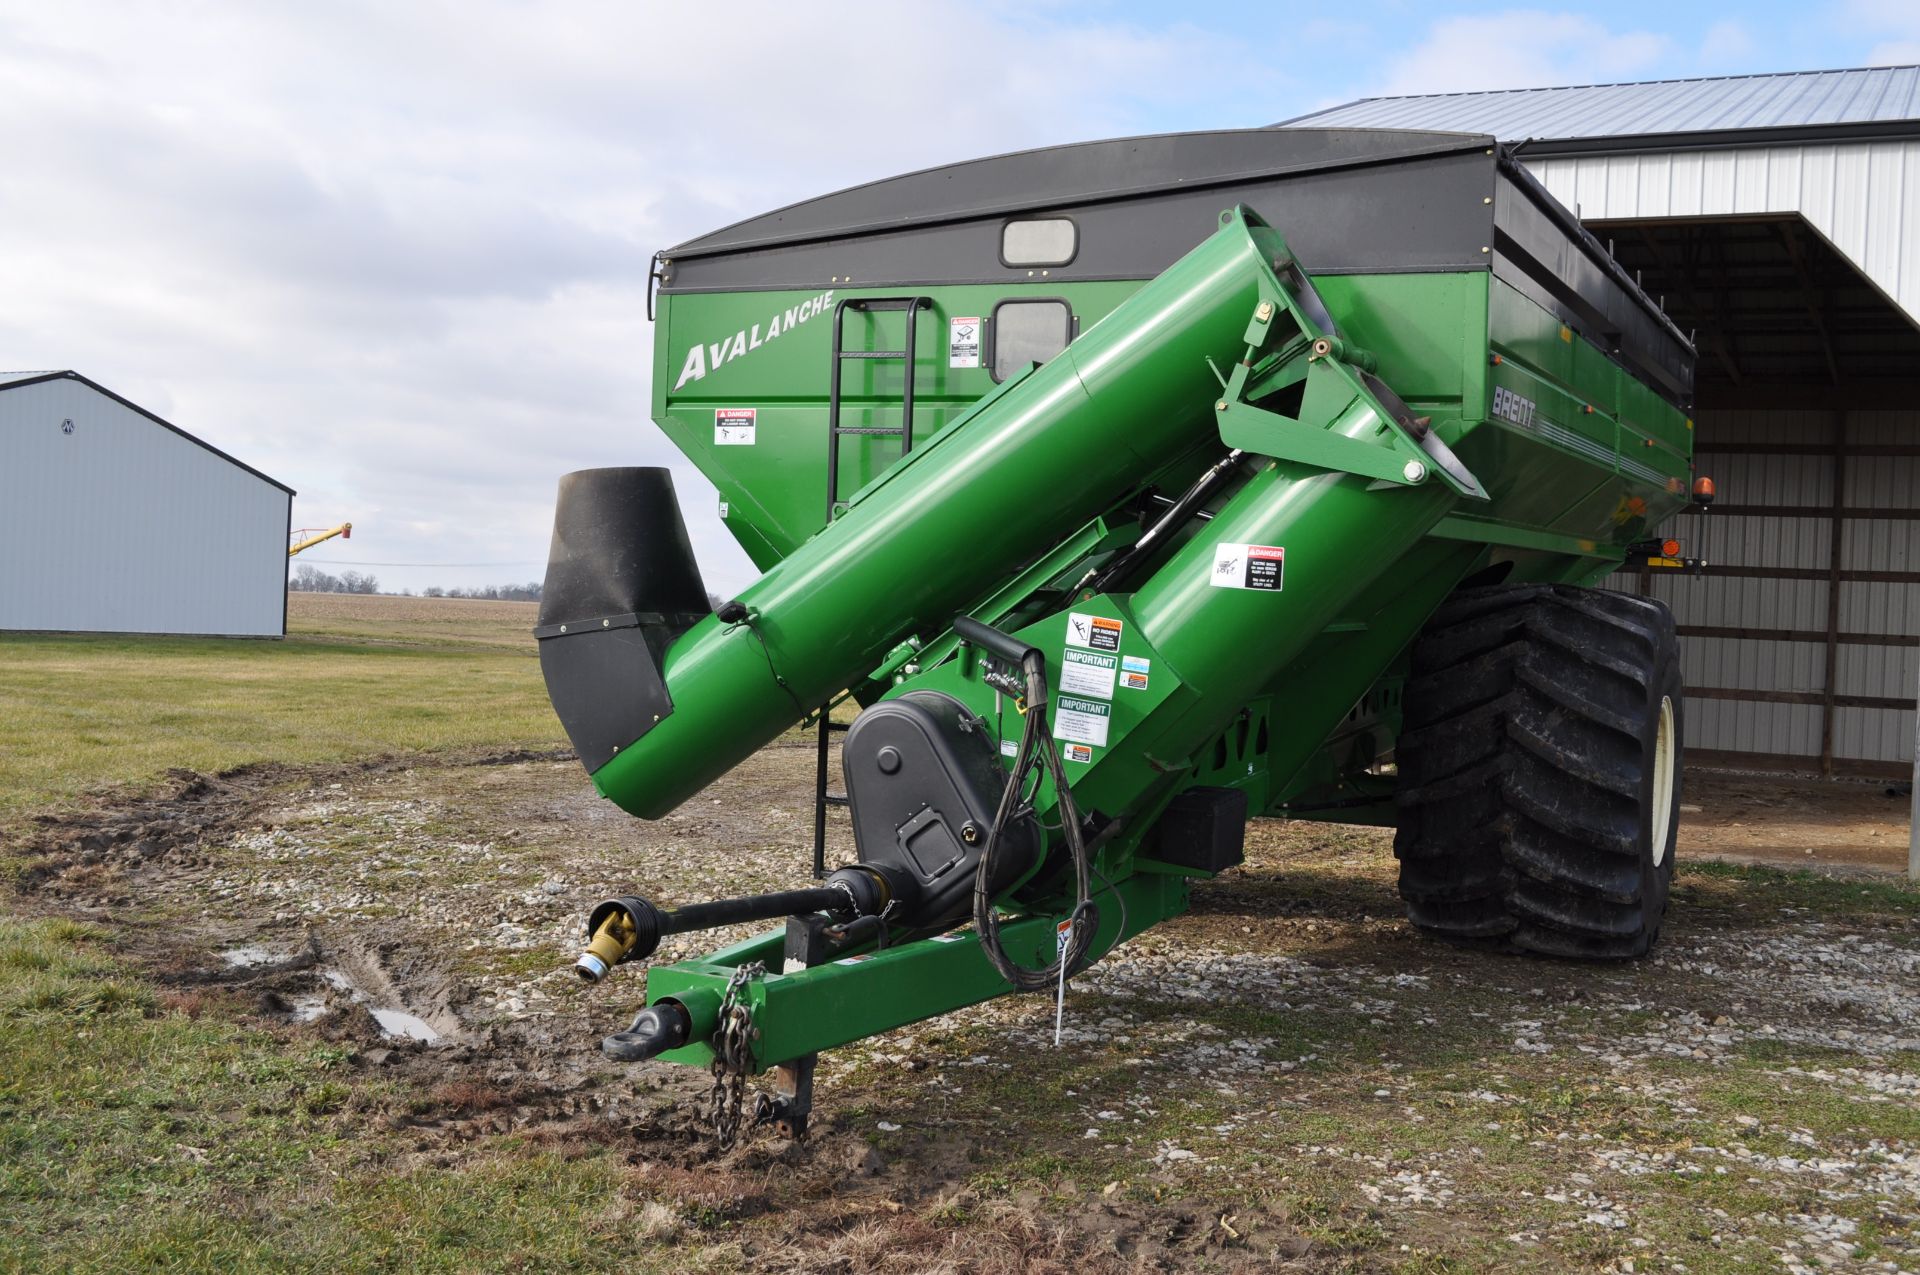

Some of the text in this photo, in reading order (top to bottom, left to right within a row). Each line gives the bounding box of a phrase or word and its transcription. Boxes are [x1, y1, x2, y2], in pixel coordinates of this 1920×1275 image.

[672, 289, 834, 393] AVALANCHE
[1492, 385, 1536, 427] BRENT
[1255, 549, 1282, 558] DANGER
[1098, 620, 1120, 628] WARNING
[1066, 651, 1115, 668] IMPORTANT
[1061, 699, 1107, 715] IMPORTANT
